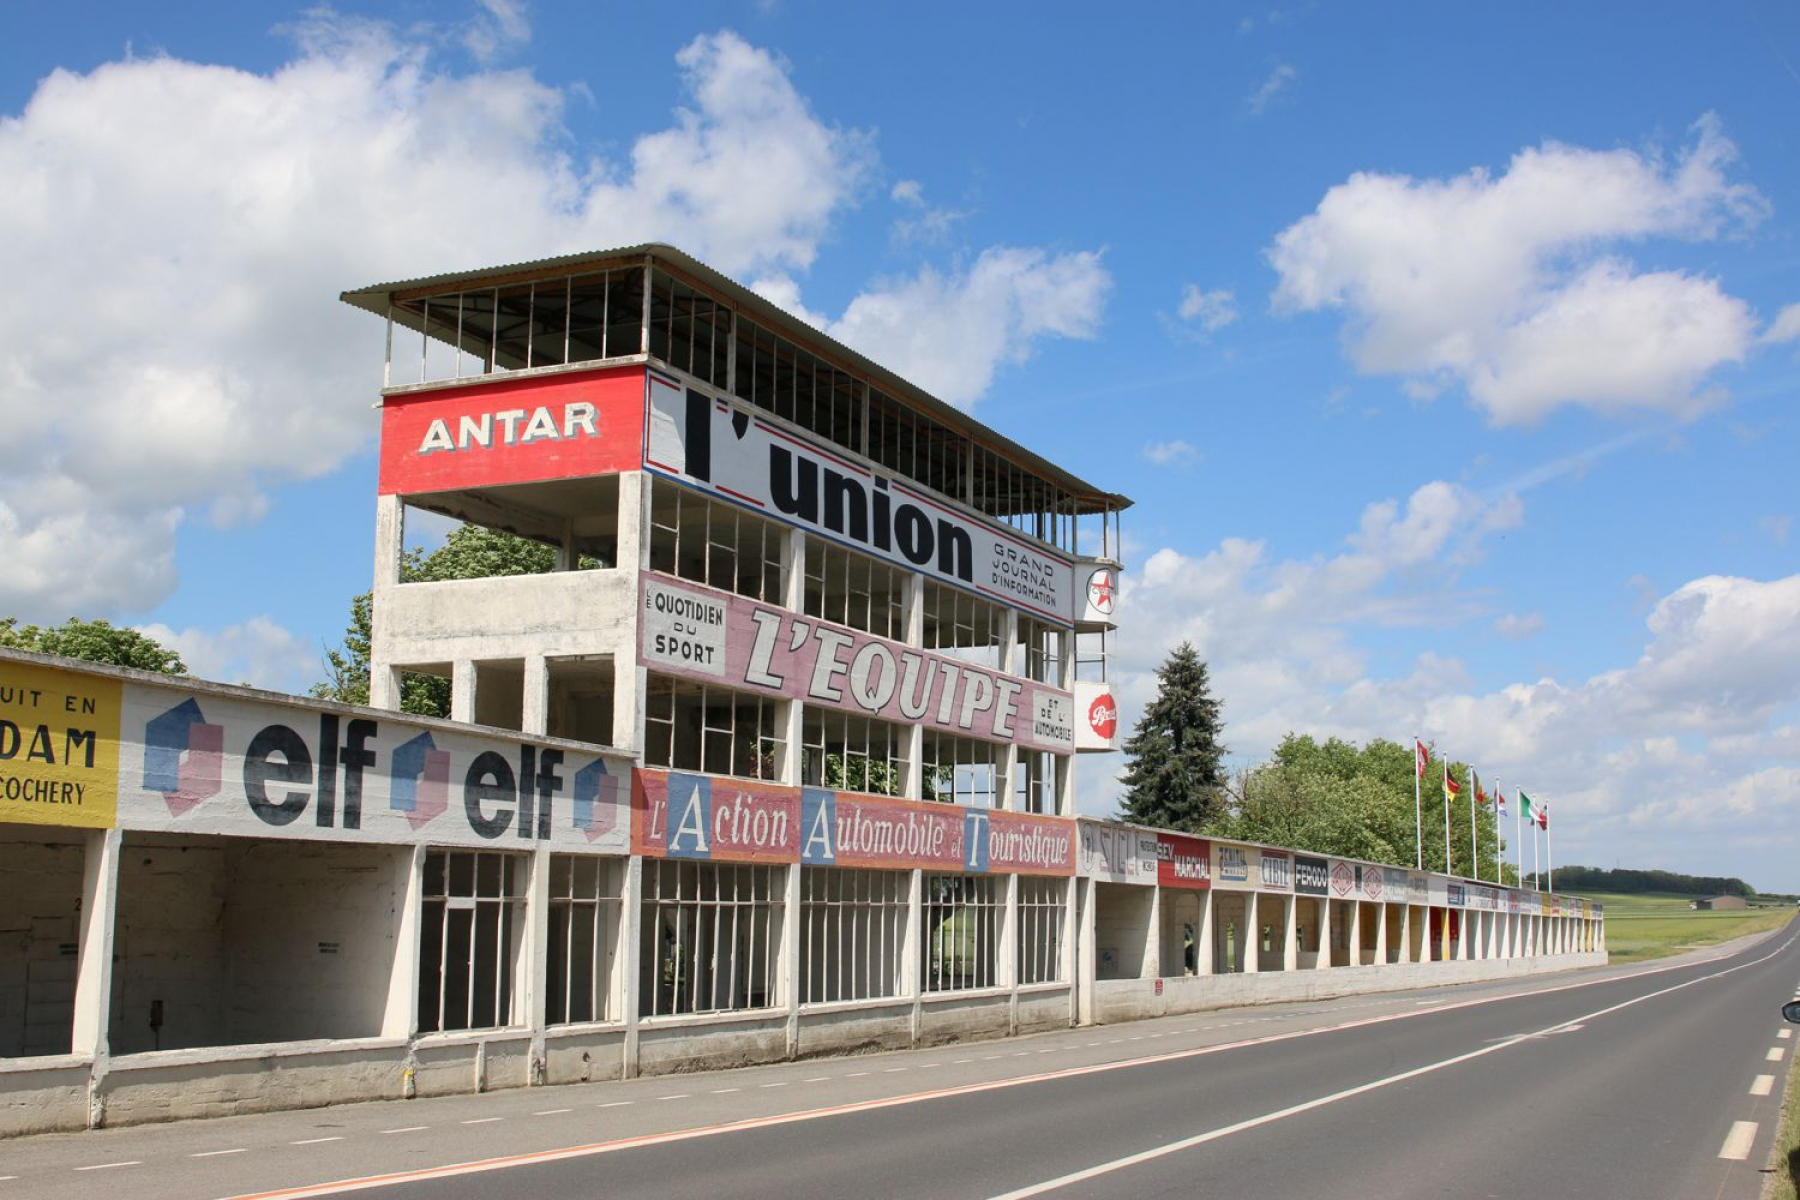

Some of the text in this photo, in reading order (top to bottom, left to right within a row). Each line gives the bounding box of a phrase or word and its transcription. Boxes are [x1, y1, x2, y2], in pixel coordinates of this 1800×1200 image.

[418, 401, 600, 455] ANTAR
[685, 388, 972, 583] l'union
[992, 561, 1055, 593] JOURNAL
[994, 543, 1053, 577] GRAND
[992, 572, 1056, 608] D'INFORMATION
[655, 592, 722, 626] QUOTIDIEN
[674, 622, 697, 635] DU
[655, 634, 714, 664] SPORT
[744, 607, 1022, 739] L'EQUIPE
[65, 695, 96, 715] EN
[1041, 708, 1051, 719] DE
[1048, 698, 1058, 709] ET
[0, 719, 96, 769] DAM
[1035, 720, 1071, 741] AUTOMOBILE
[243, 712, 378, 830] elf
[463, 743, 565, 840] elf
[802, 797, 944, 859] Automobile
[951, 836, 963, 859] et
[966, 813, 1069, 869] Touristique
[1174, 854, 1210, 879] MARCHAL
[1295, 863, 1327, 888] FERODO
